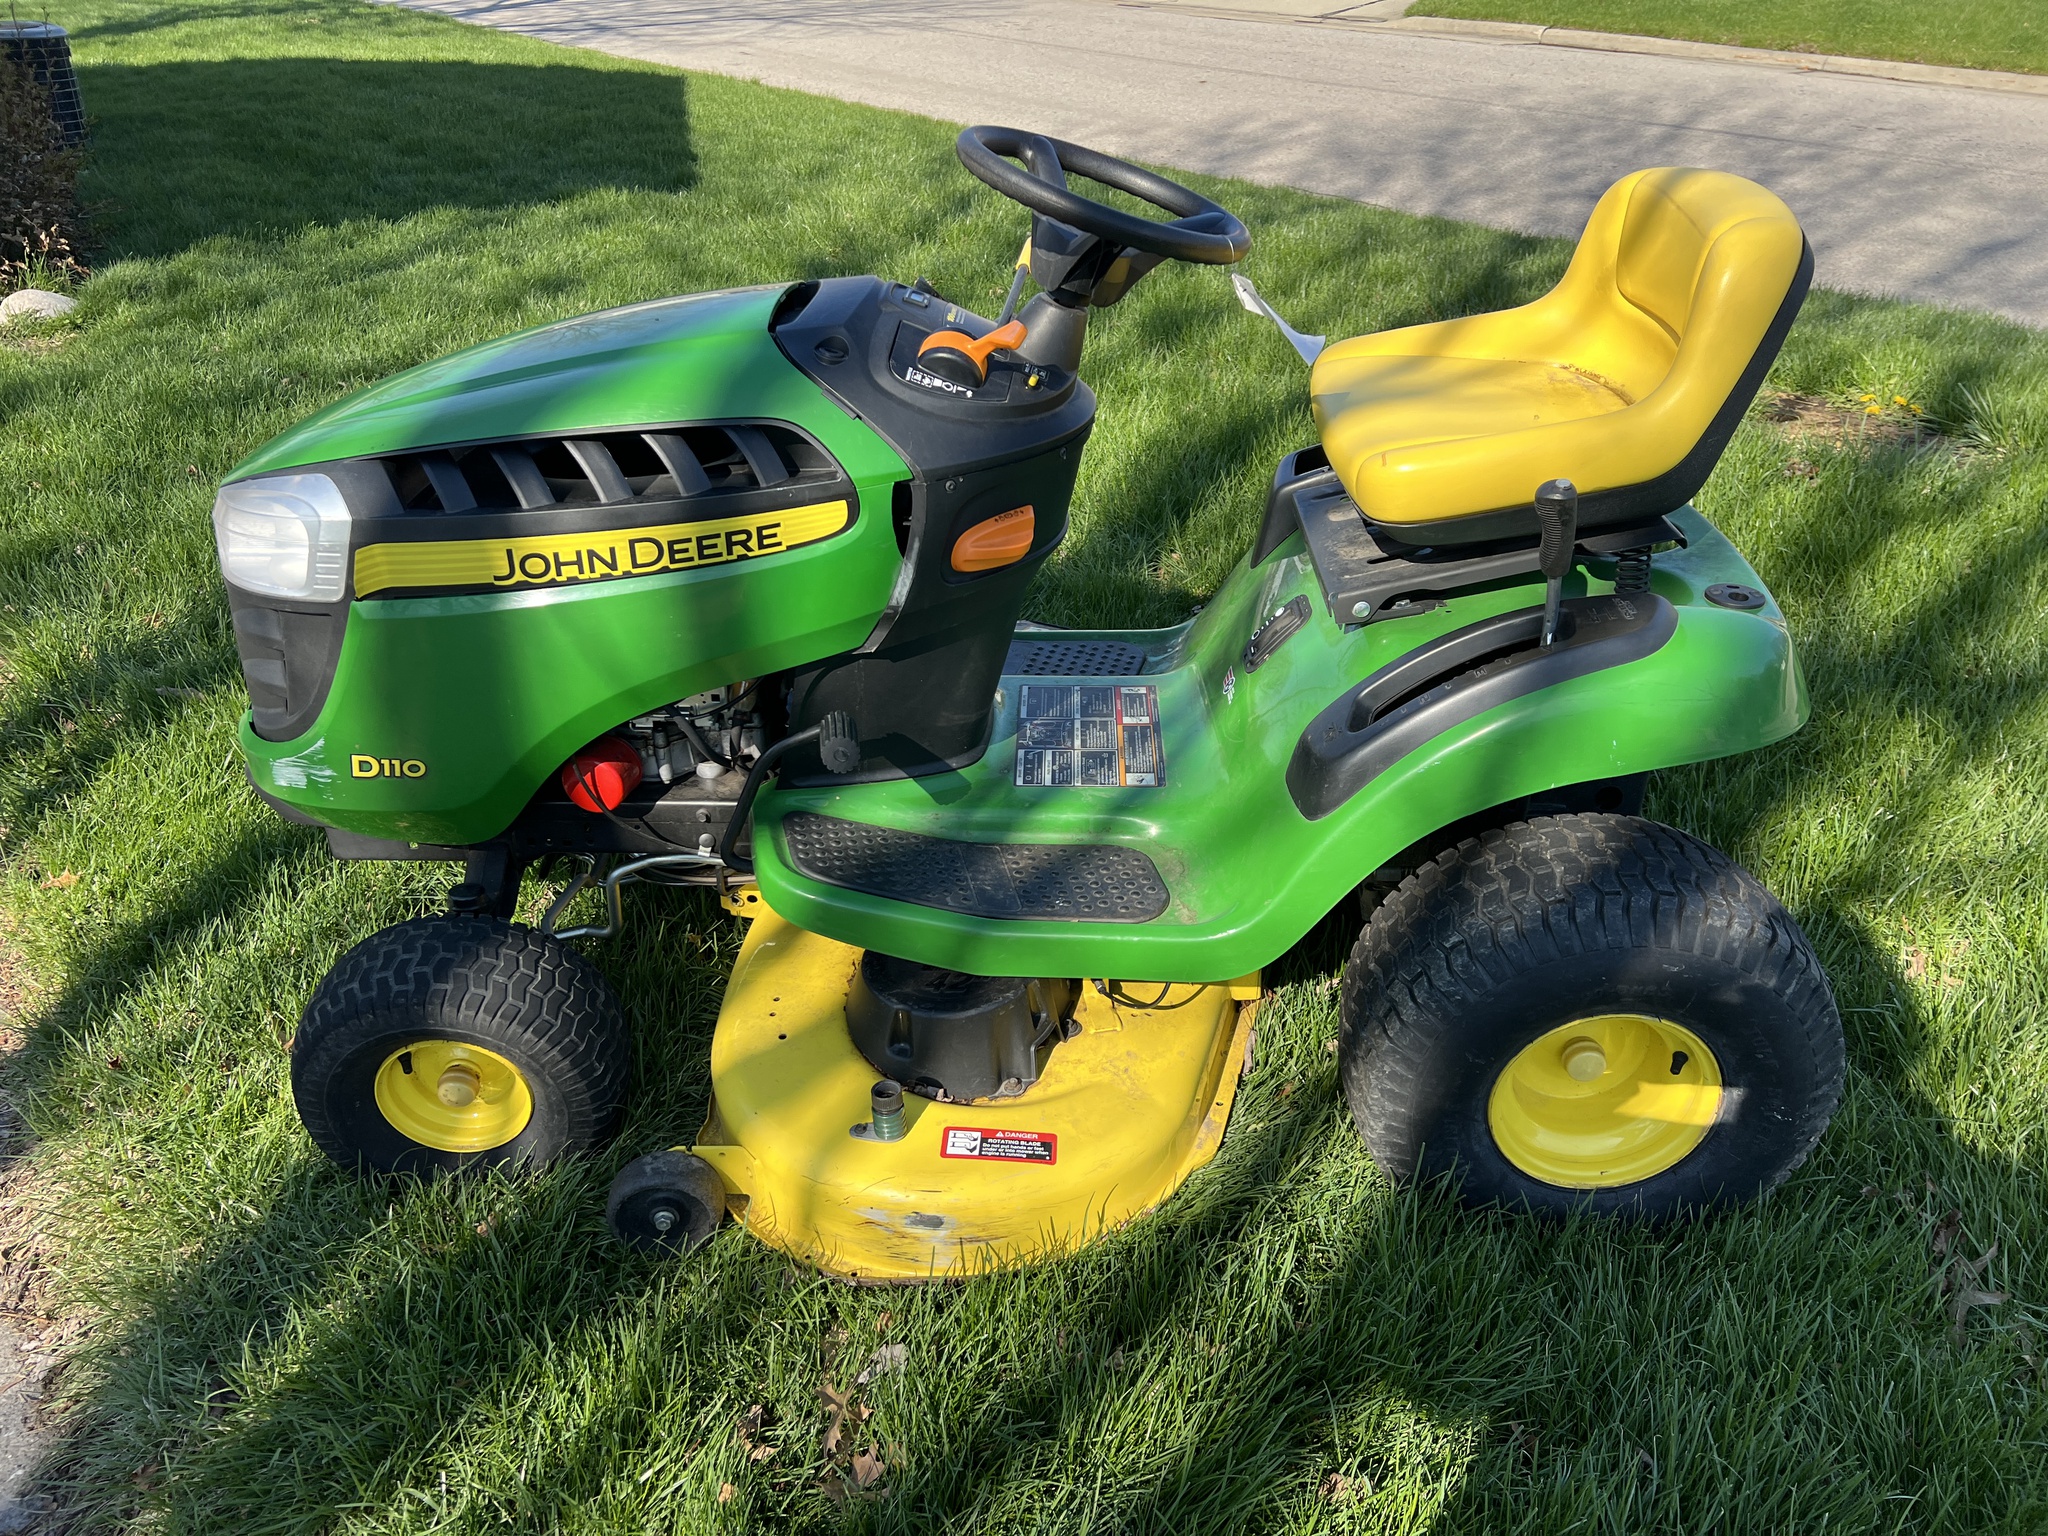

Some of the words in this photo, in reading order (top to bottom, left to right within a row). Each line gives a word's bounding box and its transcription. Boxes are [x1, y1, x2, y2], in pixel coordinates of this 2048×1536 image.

[493, 546, 620, 582] JOHN
[628, 522, 783, 569] DEERE
[350, 754, 427, 778] D110
[1005, 1131, 1038, 1139] DANGER
